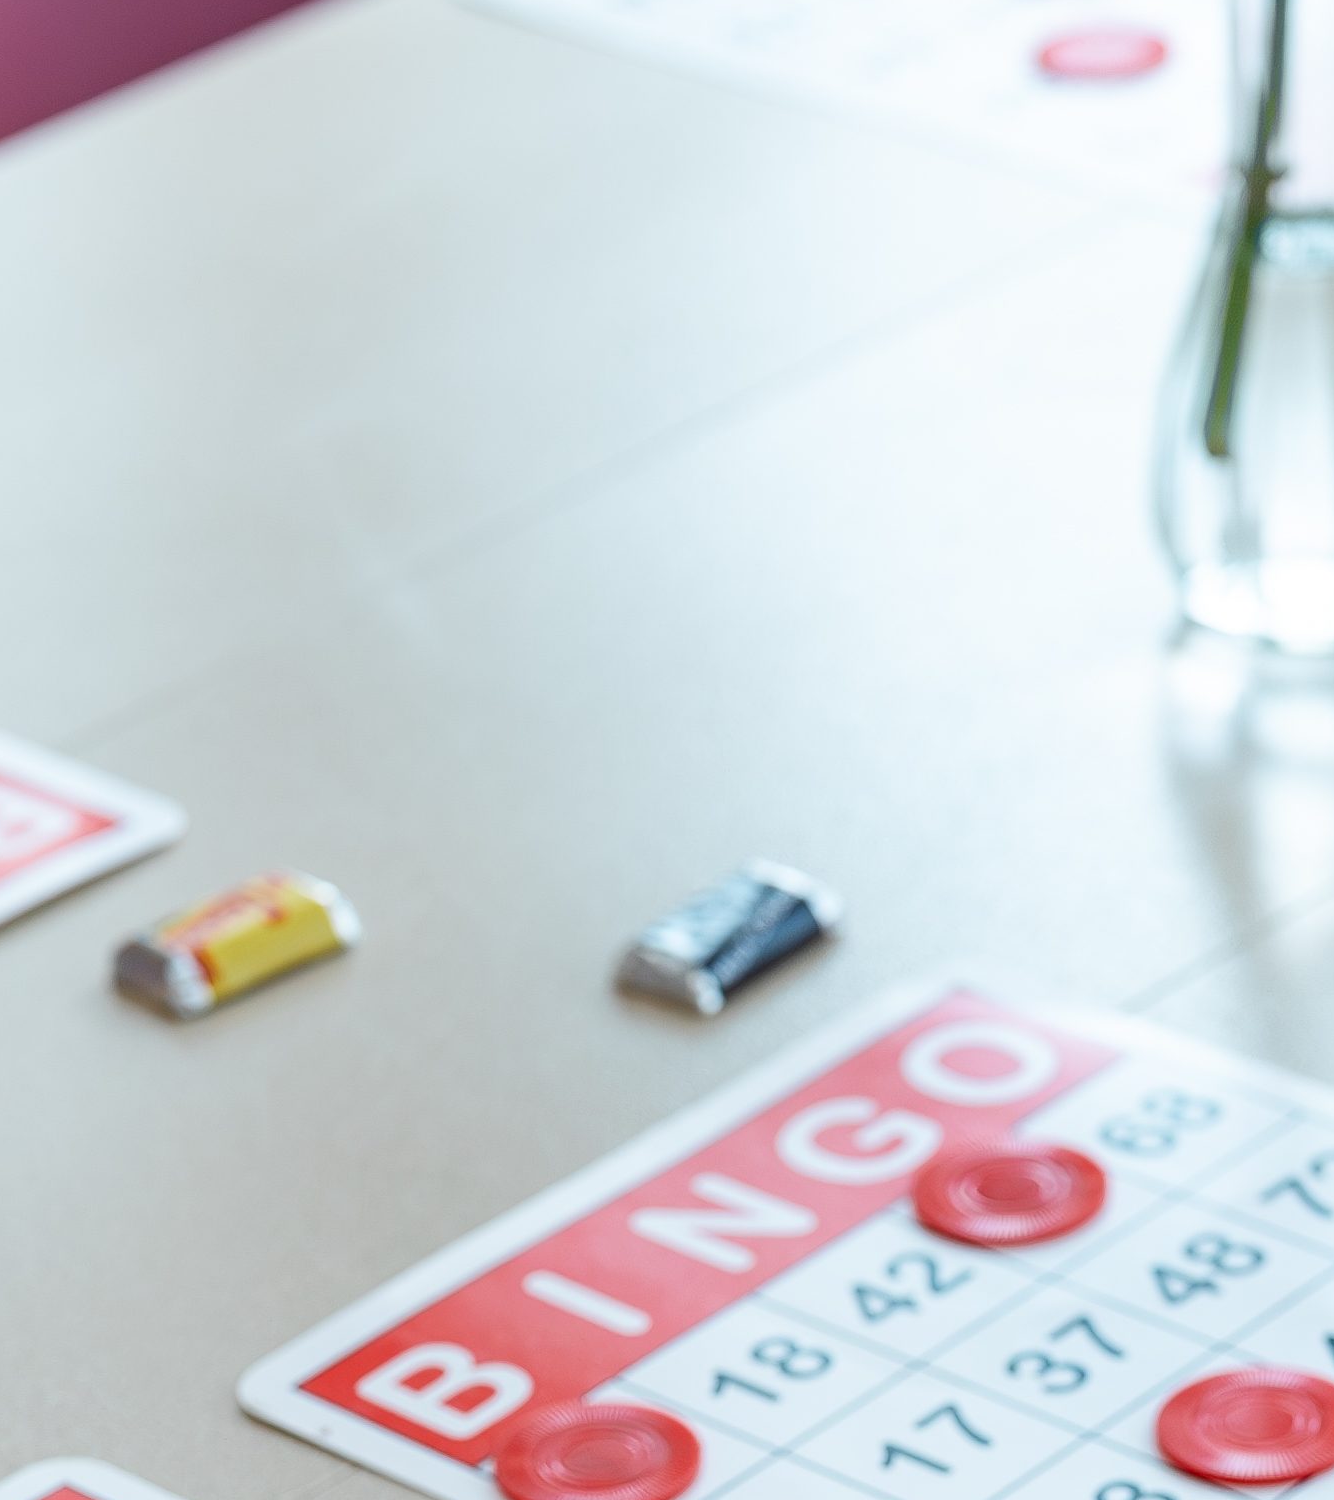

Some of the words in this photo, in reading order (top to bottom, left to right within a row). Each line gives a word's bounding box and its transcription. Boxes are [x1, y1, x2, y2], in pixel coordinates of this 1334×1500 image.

[353, 1016, 1065, 1443] BINGO
[708, 1332, 837, 1414] 18
[850, 1248, 975, 1330] 42
[1095, 1089, 1225, 1162] 68
[876, 1403, 996, 1484] 17
[1003, 1314, 1129, 1397] 37
[1144, 1229, 1269, 1311] 48
